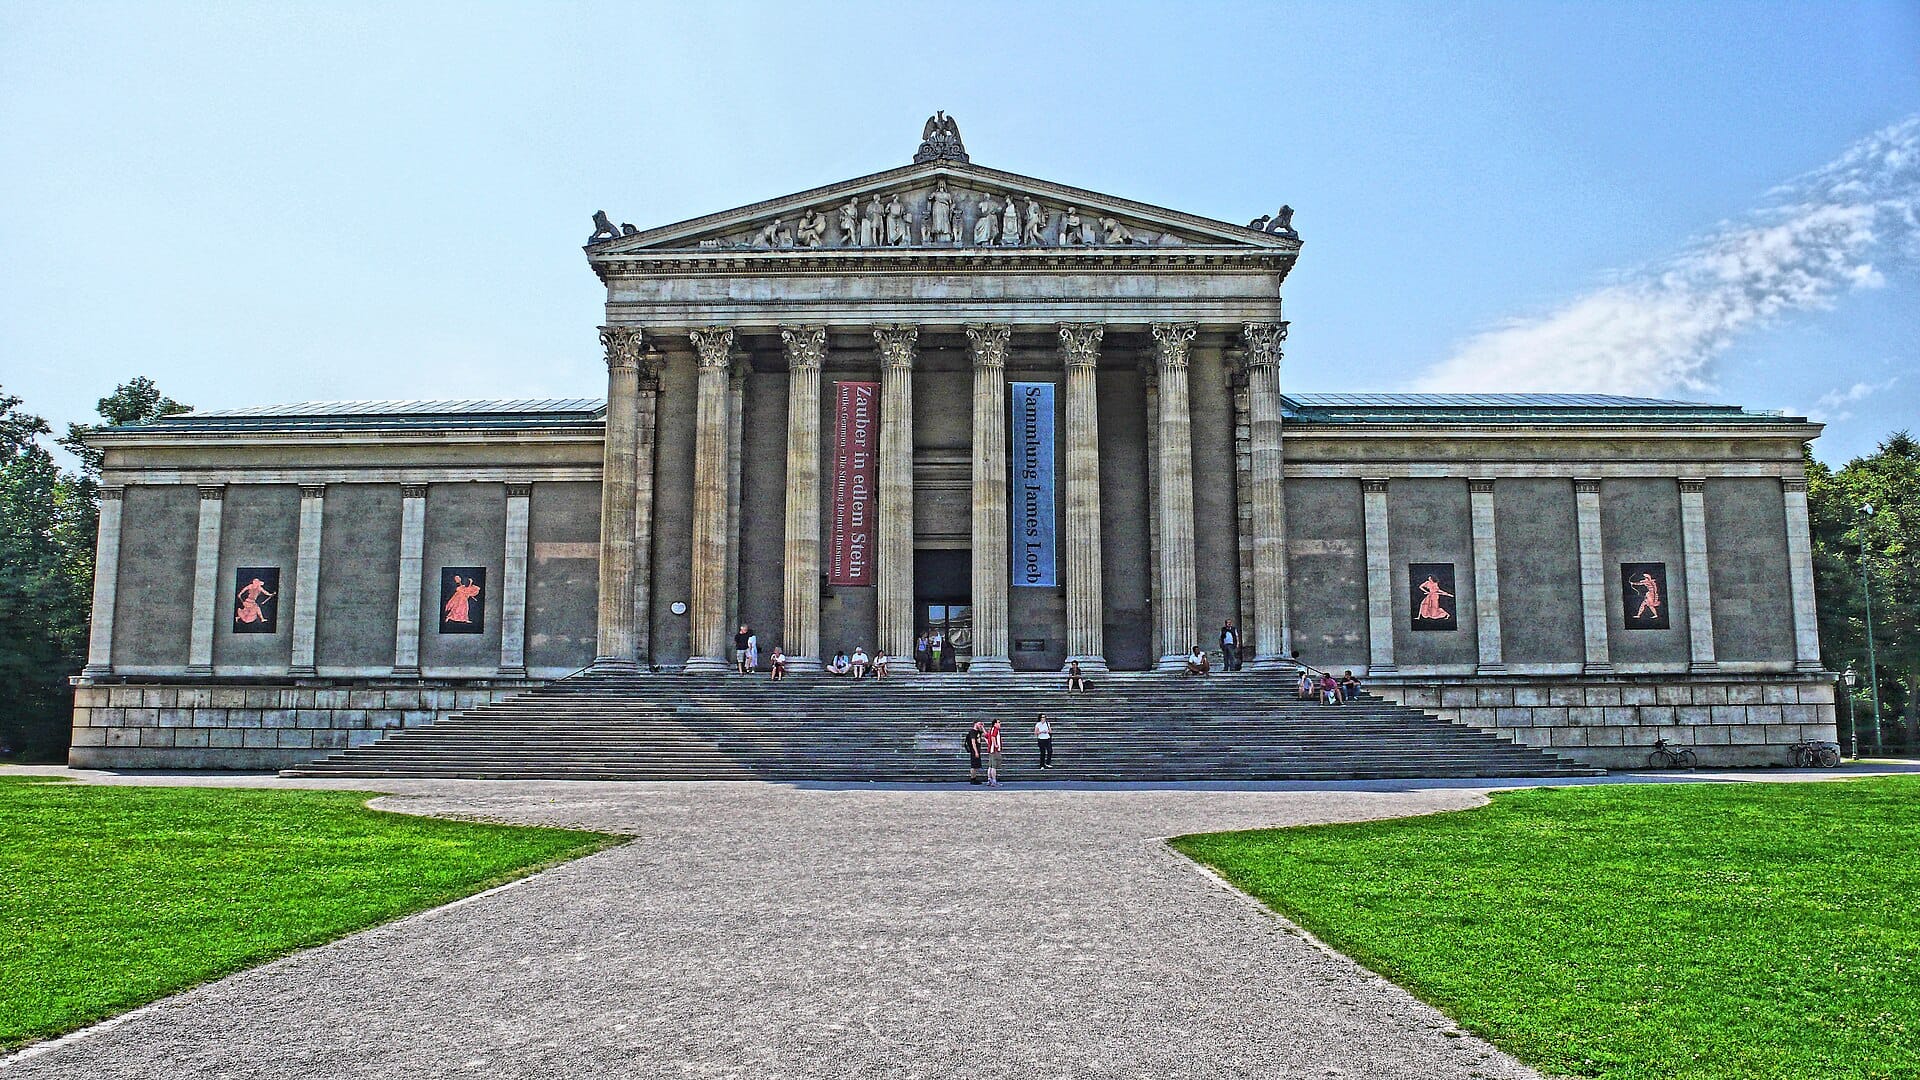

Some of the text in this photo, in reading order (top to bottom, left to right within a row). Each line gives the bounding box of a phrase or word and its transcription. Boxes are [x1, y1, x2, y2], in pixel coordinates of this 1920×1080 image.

[841, 385, 850, 411] Antike
[840, 412, 849, 447] Gemmen
[839, 455, 847, 469] Die
[836, 470, 847, 502] Stiftung
[849, 386, 872, 578] Zauber in edlem Stein
[1022, 386, 1042, 584] Sammlung James Loeb
[836, 503, 845, 532] Helmut
[834, 534, 844, 577] Hansmann
